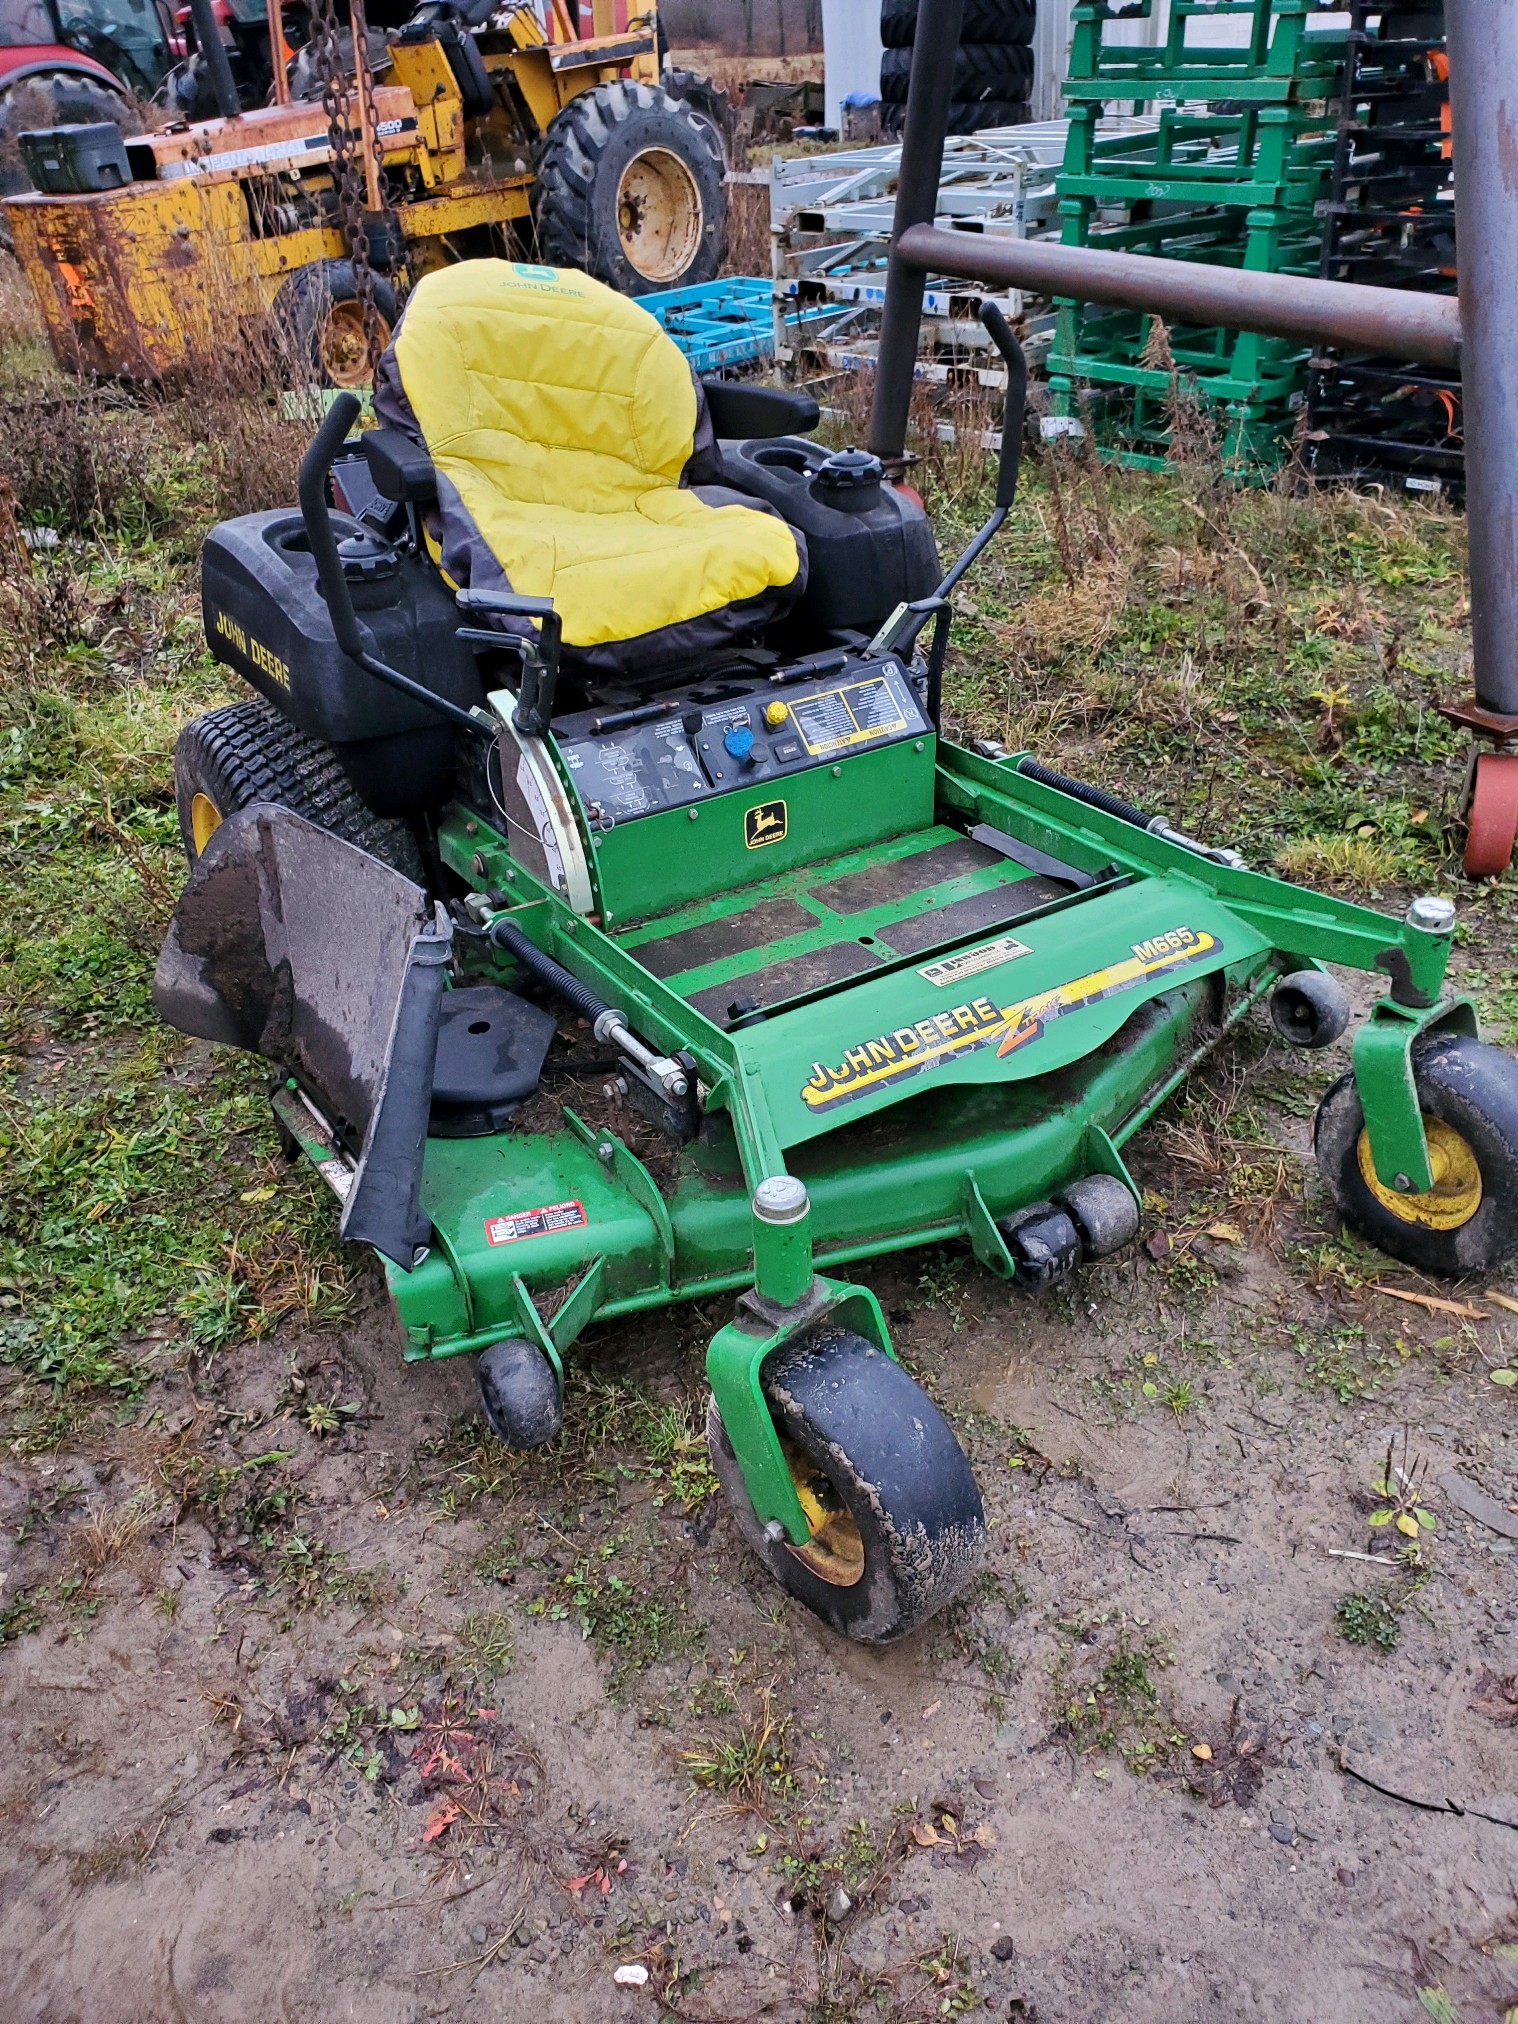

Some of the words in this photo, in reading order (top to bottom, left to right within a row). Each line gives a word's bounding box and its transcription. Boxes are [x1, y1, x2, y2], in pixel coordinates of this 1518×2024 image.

[499, 281, 538, 290] JOHN
[540, 283, 586, 298] DEERE
[216, 610, 247, 655] JOHN
[250, 637, 291, 693] DEERE
[869, 724, 892, 736] CAUTION
[749, 836, 765, 846] JOHN
[765, 830, 784, 840] DEERE
[1131, 926, 1195, 961] M665
[895, 997, 998, 1054] DEERE
[505, 1211, 532, 1222] DANGER
[548, 1201, 576, 1212] PELIGRO
